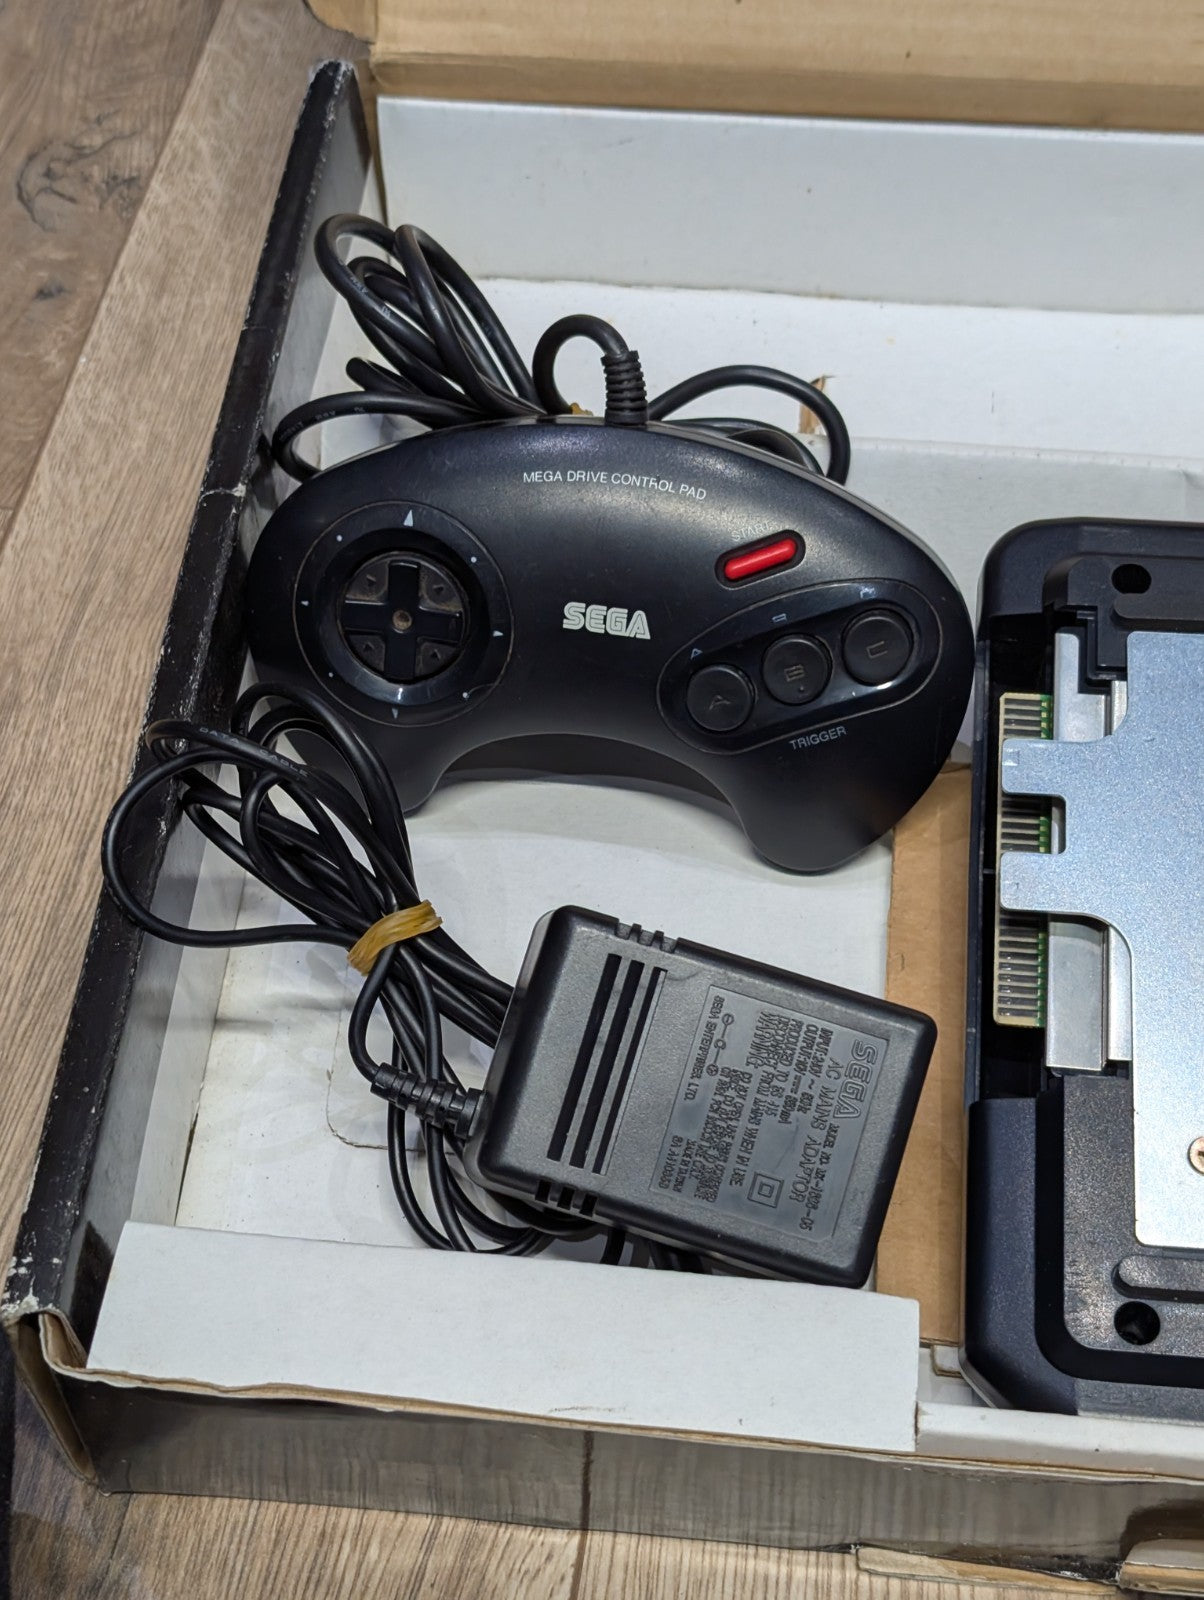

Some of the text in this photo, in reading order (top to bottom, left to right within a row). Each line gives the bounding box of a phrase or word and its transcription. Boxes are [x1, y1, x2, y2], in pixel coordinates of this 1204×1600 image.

[523, 470, 707, 500] MEGA DRIVE CONTROL PAD
[562, 601, 651, 640] SEGA
[200, 726, 240, 744] DATA
[789, 725, 847, 751] TRIGGER
[745, 1012, 779, 1069] WARNING:
[774, 1069, 790, 1083] TO
[832, 1041, 878, 1119] SEGA
[788, 1057, 844, 1203] AC MAINS ADAPTOR
